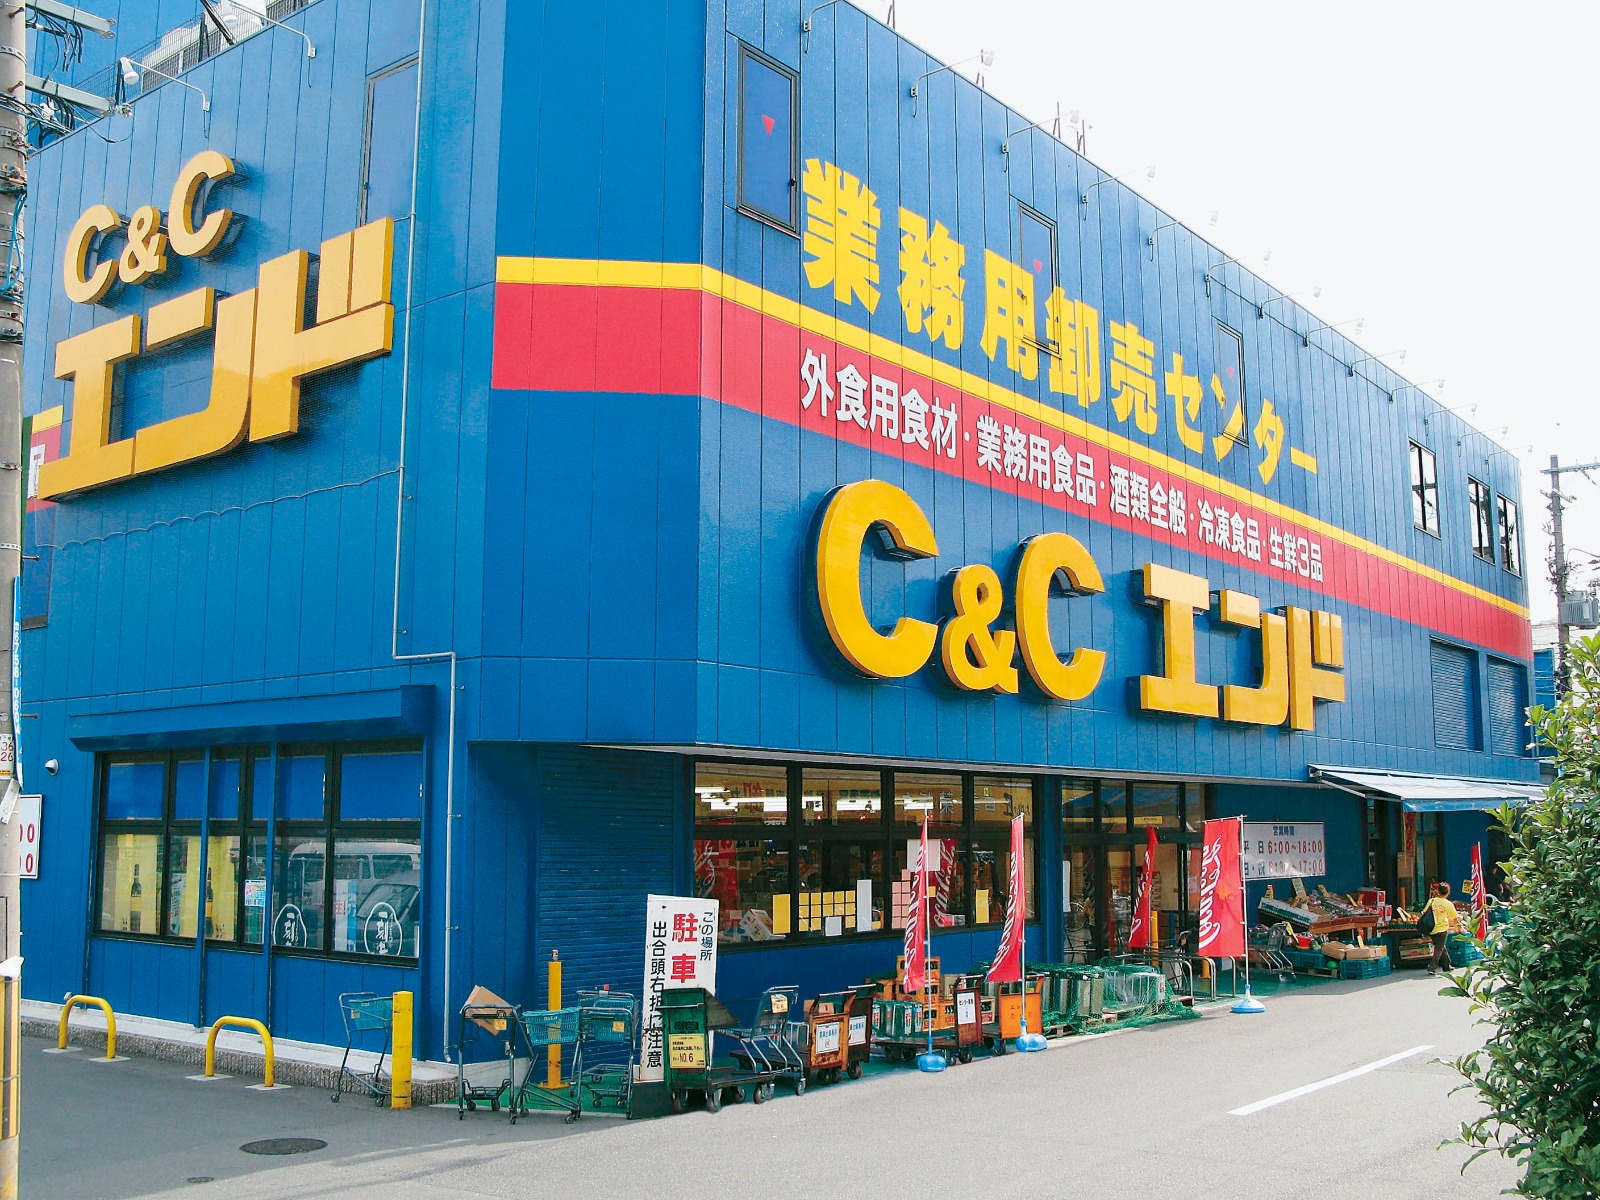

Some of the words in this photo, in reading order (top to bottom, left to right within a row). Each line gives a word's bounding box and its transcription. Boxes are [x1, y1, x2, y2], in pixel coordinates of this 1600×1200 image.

[64, 150, 236, 304] C&C
[802, 158, 1318, 485] 業務用卸売センター
[37, 217, 394, 500] エンド
[816, 479, 1107, 701] C&C
[1140, 562, 1346, 731] エンド
[671, 912, 699, 983] 駐車
[700, 911, 714, 961] この場所
